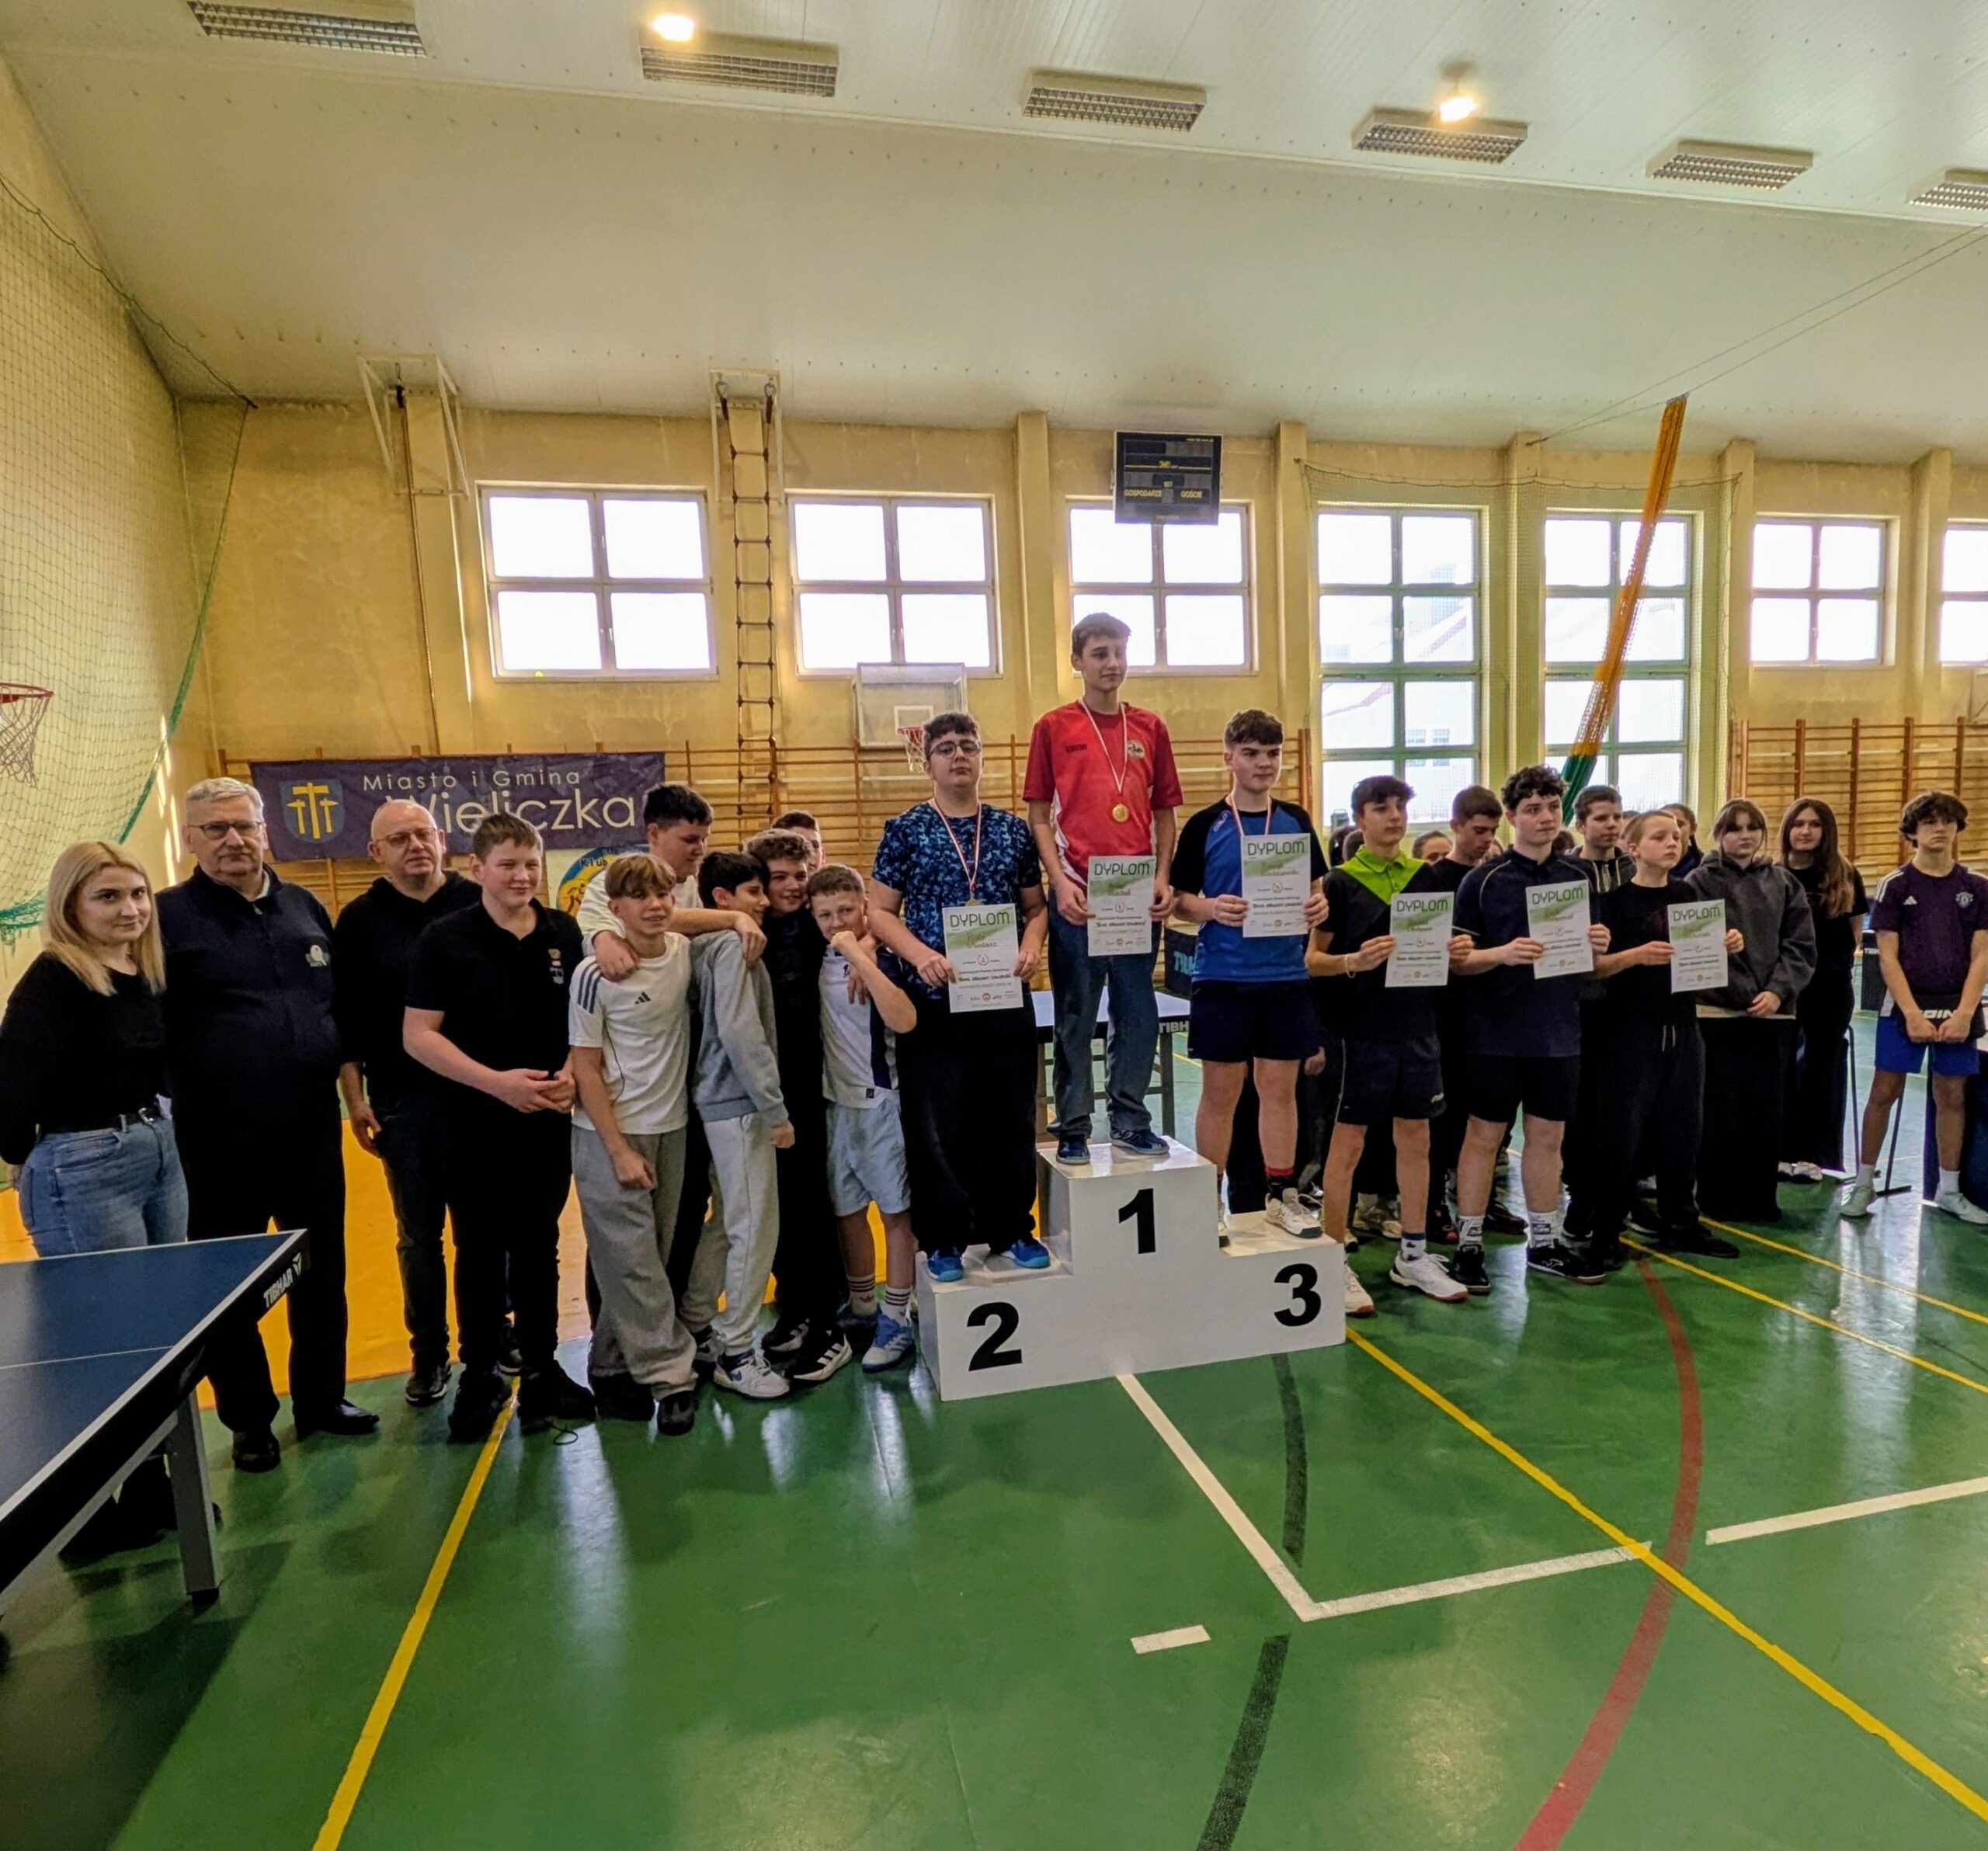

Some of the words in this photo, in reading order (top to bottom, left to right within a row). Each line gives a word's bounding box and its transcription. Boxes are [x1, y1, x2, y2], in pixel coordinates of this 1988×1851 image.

[363, 772, 457, 790] Miasto
[471, 770, 478, 787] i
[492, 769, 581, 787] Gmina
[1247, 841, 1305, 856] DYPLOM
[1093, 863, 1150, 876] DYPLOM
[1531, 887, 1583, 905] DYPLOM
[1396, 899, 1448, 912] DYPLOM
[1673, 907, 1721, 922] DYPLOM
[950, 912, 1010, 928] DYPLOM
[1118, 1188, 1156, 1255] 1
[263, 1267, 294, 1308] TIBHAR
[1274, 1263, 1322, 1327] 3
[966, 1301, 1023, 1371] 2
